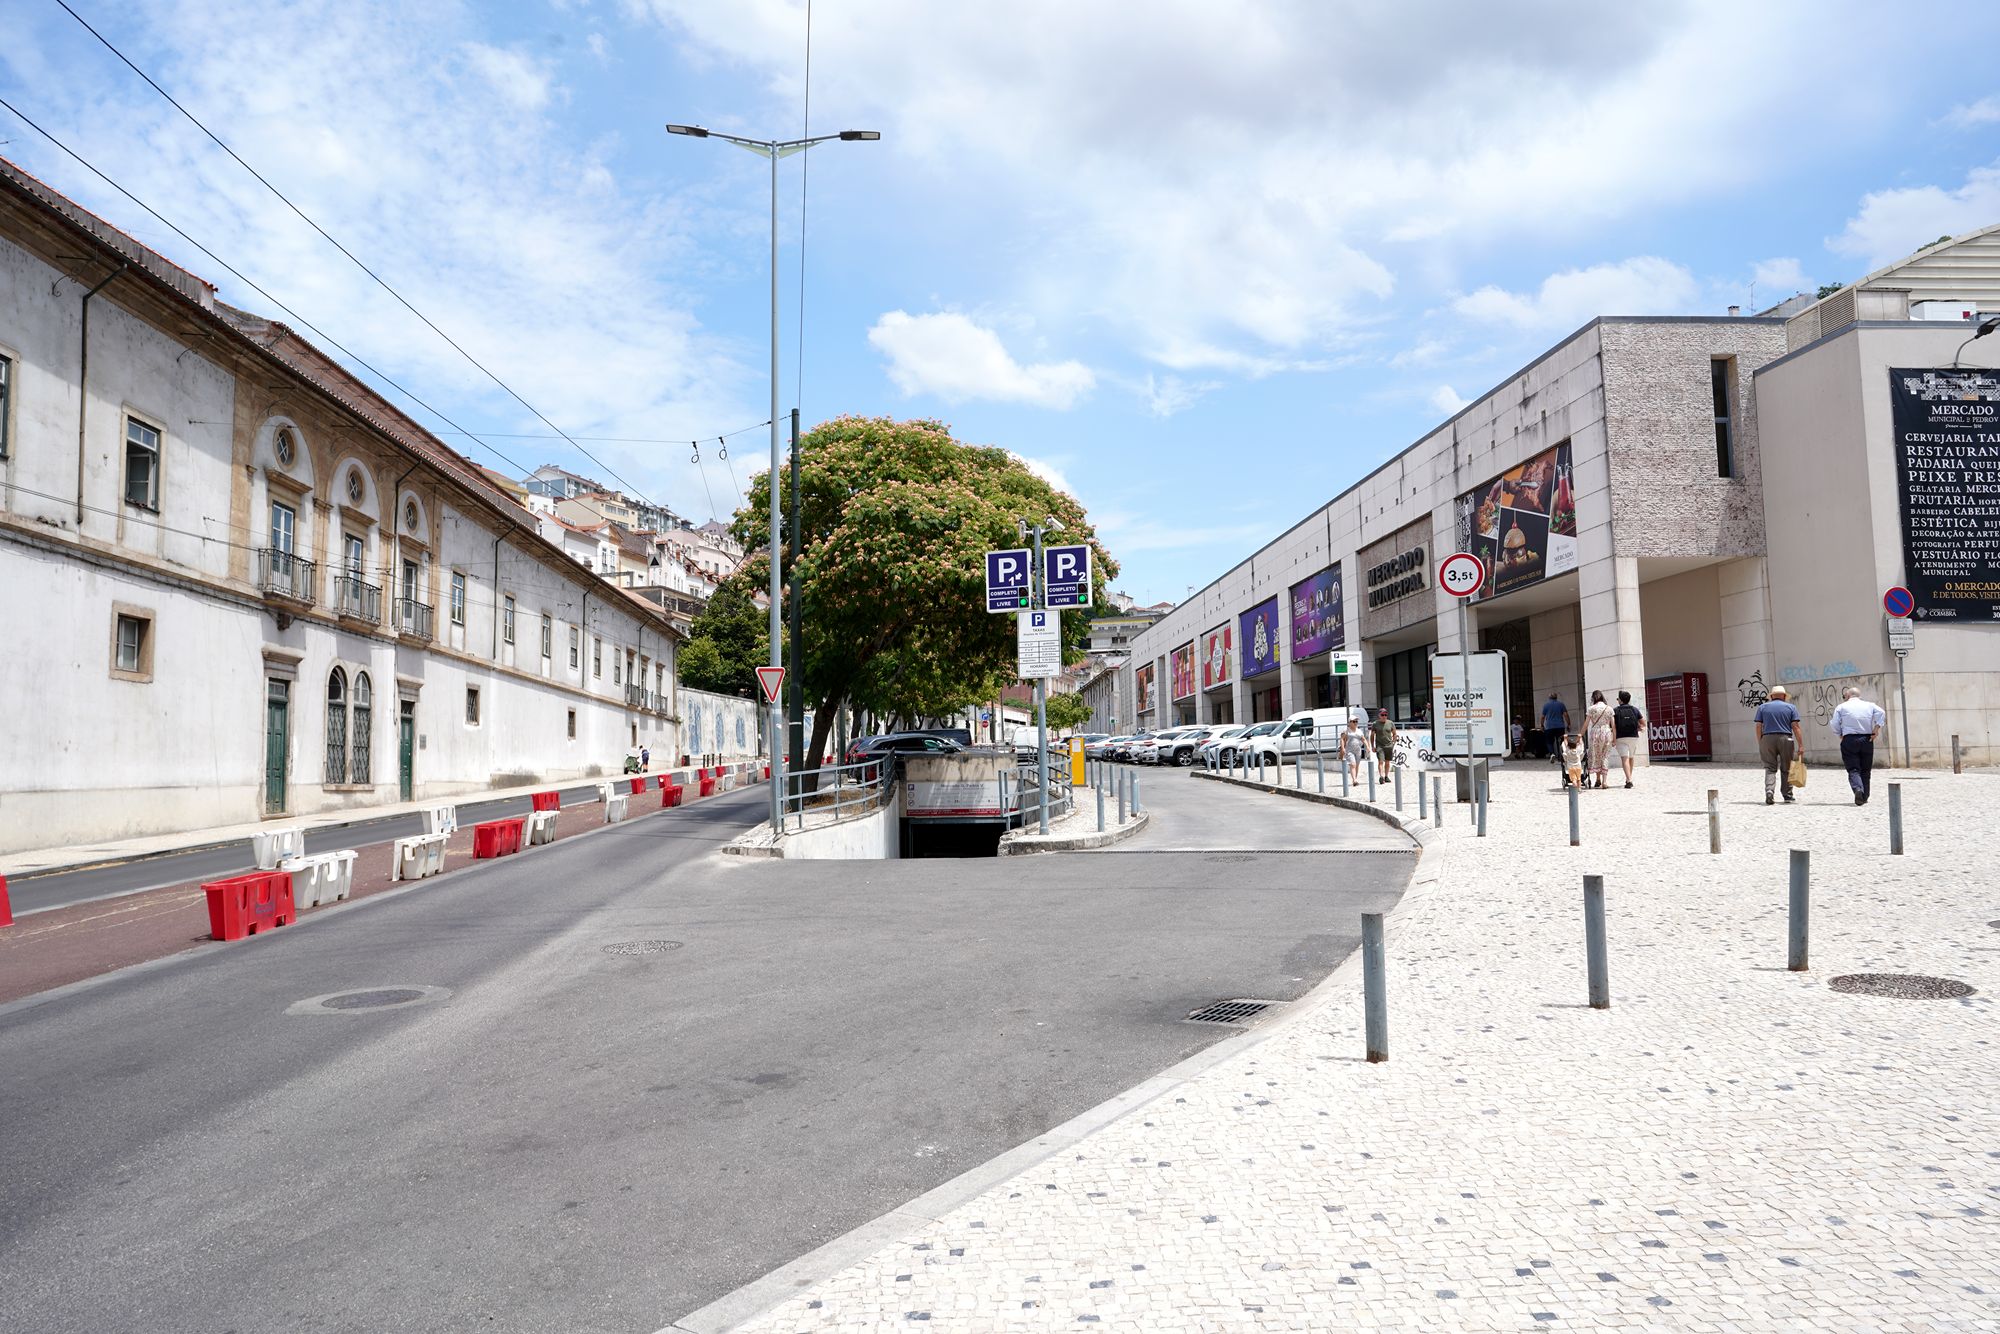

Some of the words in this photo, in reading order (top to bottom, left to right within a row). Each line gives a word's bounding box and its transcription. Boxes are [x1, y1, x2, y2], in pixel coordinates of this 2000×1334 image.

[1931, 405, 1994, 415] MERCADO
[1905, 433, 1973, 444] CERVEJARIA
[1906, 445, 1999, 456] RESTAURAN
[1907, 458, 1965, 469] PADARIA
[1908, 470, 1956, 482] PEIXE
[1909, 485, 1961, 493] GELATARIA
[1910, 494, 1976, 505] FRUTARIA
[1911, 516, 1978, 528] ESTÉTICA
[1911, 530, 1965, 539] DECORAÇÃO
[1912, 549, 1980, 559] VESTUÁRIO
[998, 557, 1017, 583] P
[1008, 576, 1015, 586] 1
[1057, 553, 1076, 579] P
[1079, 571, 1086, 581] 2
[1368, 547, 1424, 587] MERCADO
[1448, 570, 1473, 583] 3,5t
[1369, 572, 1426, 608] MUNICIPAL
[1945, 582, 1952, 590] O
[1035, 614, 1042, 625] P
[1649, 721, 1687, 740] baixa
[1652, 740, 1687, 751] COIMBRA
